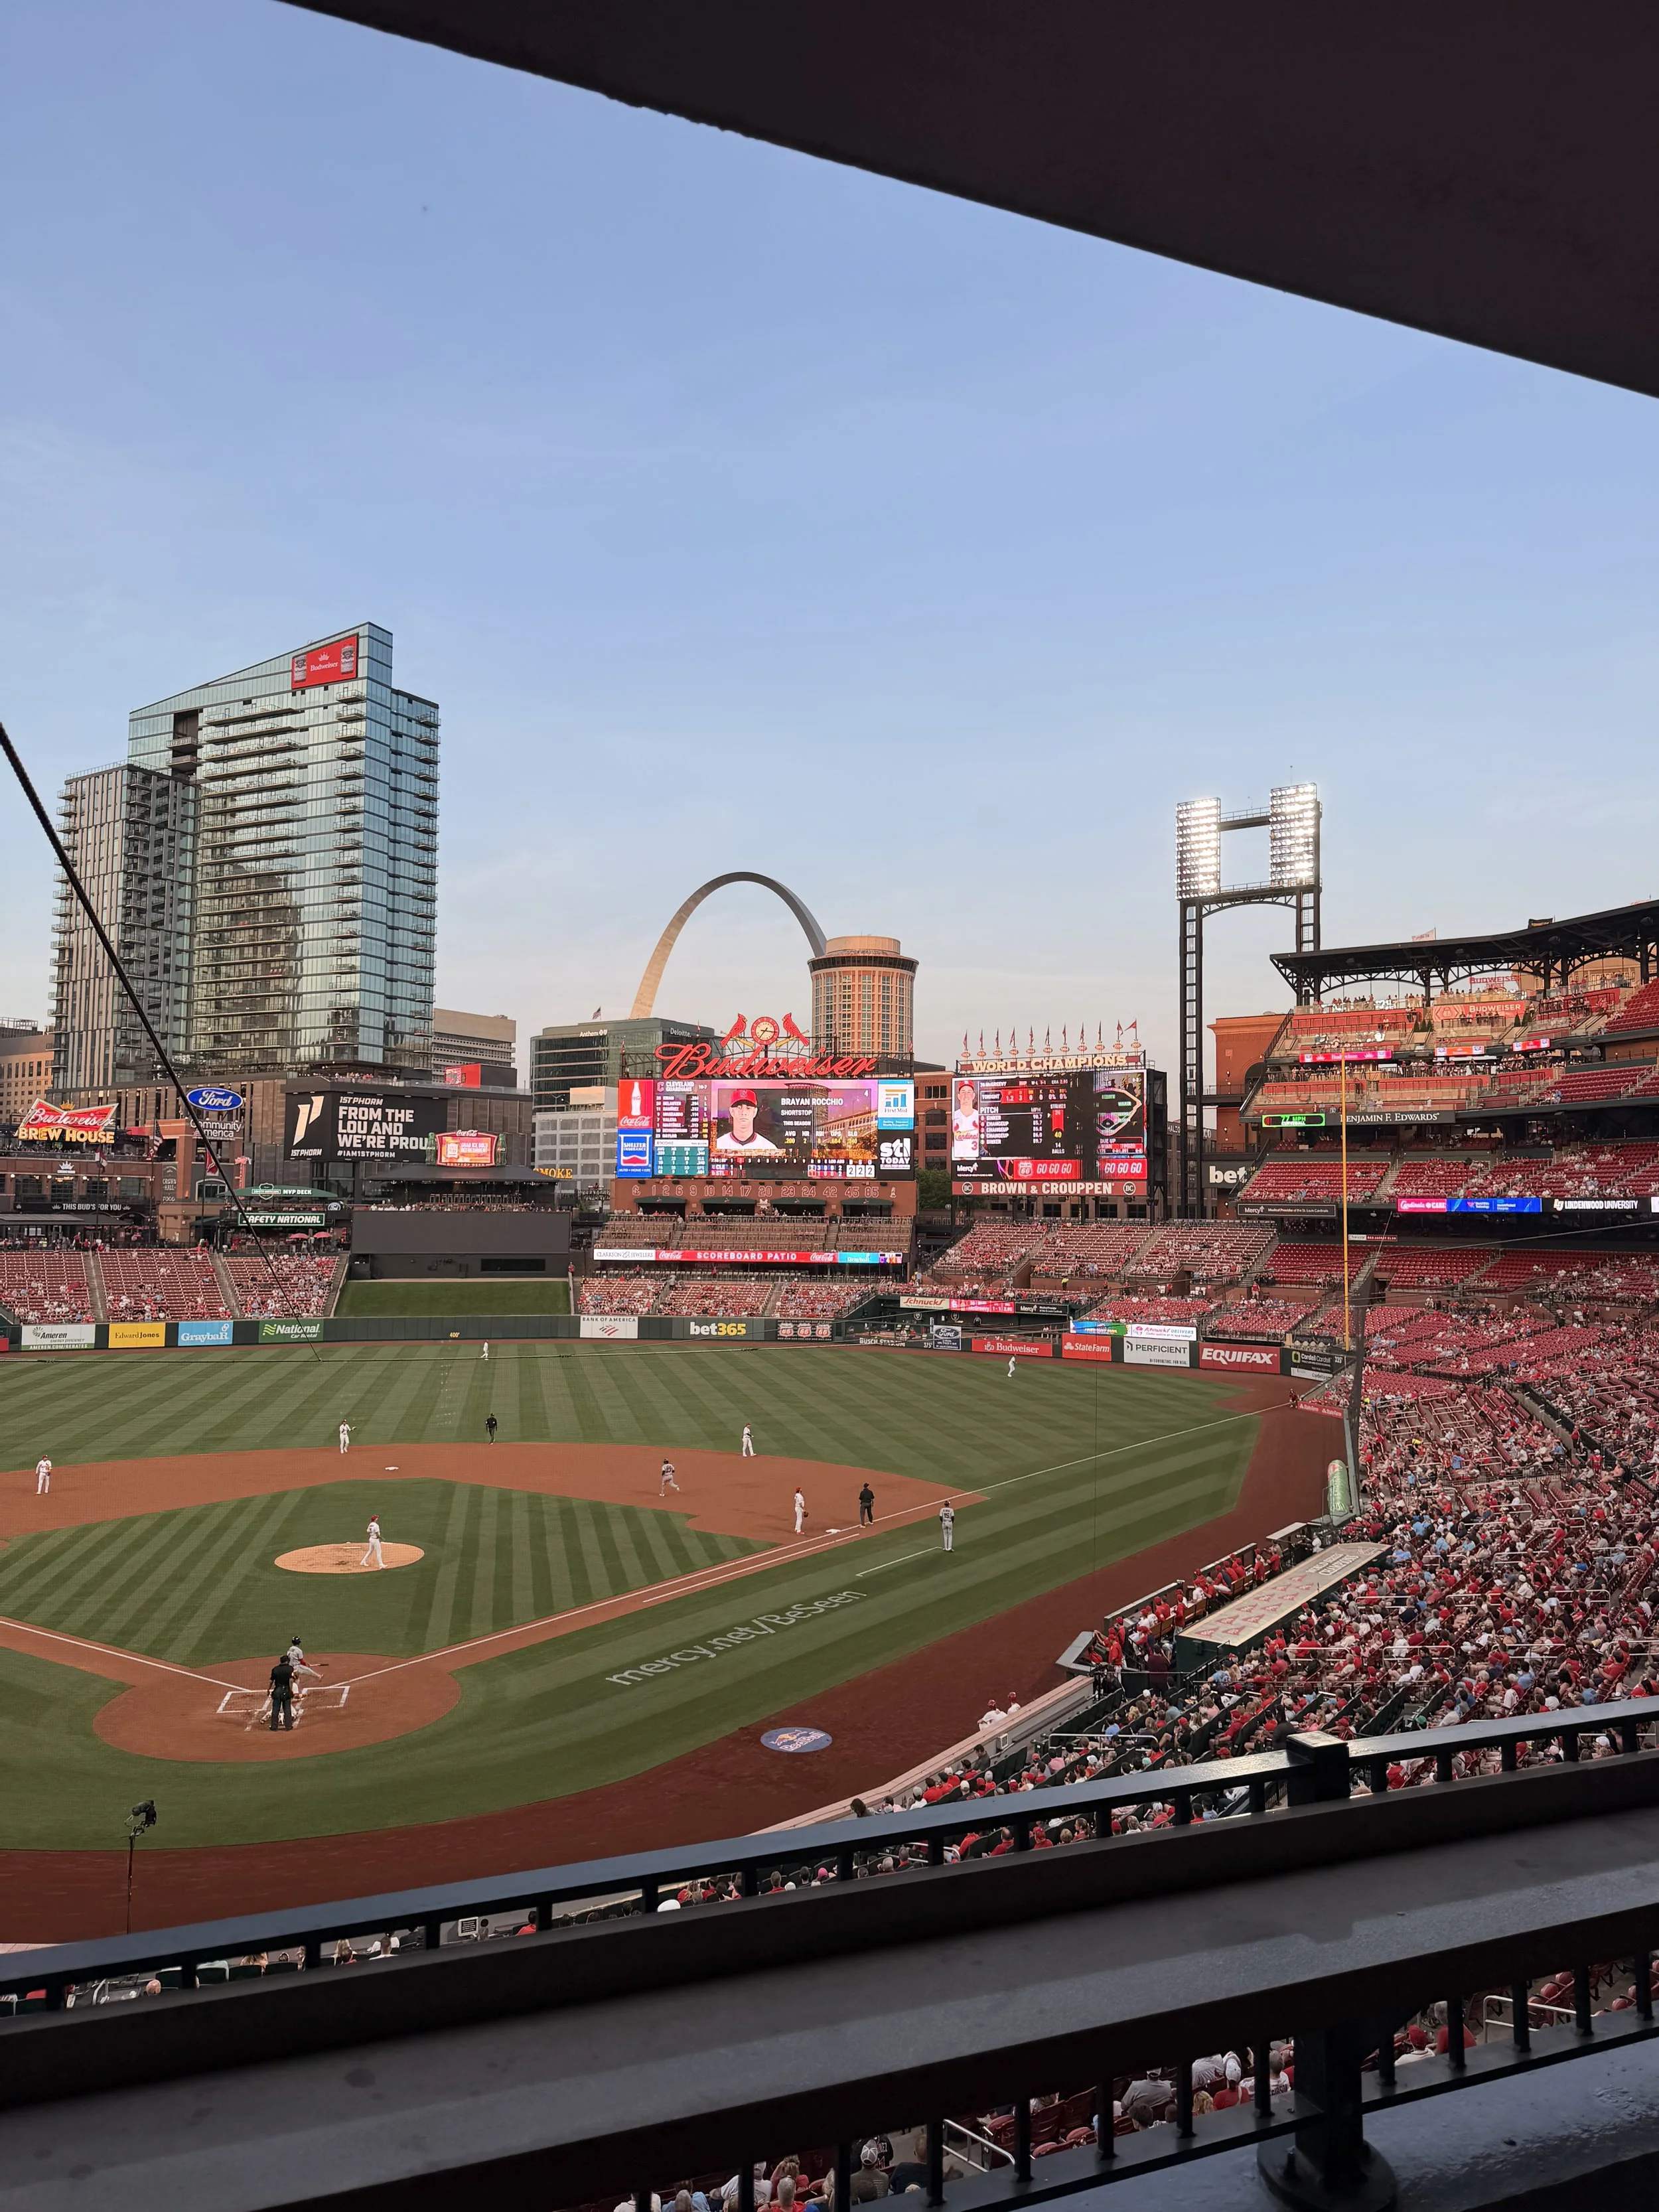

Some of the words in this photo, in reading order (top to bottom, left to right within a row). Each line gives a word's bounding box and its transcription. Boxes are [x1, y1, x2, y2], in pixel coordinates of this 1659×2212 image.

[310, 662, 338, 672] Budweiser
[1469, 1003, 1520, 1013] BUDWEISER
[654, 1043, 877, 1079] Budweiser
[973, 1061, 1027, 1072] WORLD
[1031, 1056, 1127, 1070] CHAMPIONS
[198, 1090, 233, 1107] Ford
[29, 1108, 115, 1126] Budweiser
[338, 1106, 382, 1121] FROM
[386, 1109, 414, 1122] THE
[1340, 1114, 1383, 1124] ENJAMIN
[1386, 1114, 1392, 1122] F.
[1395, 1113, 1437, 1122] EDWARDS
[620, 1116, 652, 1126] Coca-Cola
[338, 1120, 368, 1134] LOU
[371, 1122, 403, 1136] AND
[19, 1128, 62, 1141] BREW
[65, 1128, 115, 1143] HOUSE
[337, 1134, 386, 1149] WE'RE
[390, 1136, 437, 1150] PROU
[880, 1138, 910, 1157] stl
[1037, 1163, 1046, 1173] GO
[1049, 1163, 1059, 1173] GO
[1062, 1163, 1072, 1173] GO
[1104, 1163, 1115, 1173] GO
[1118, 1163, 1127, 1173] GO
[652, 1185, 656, 1196] 1
[662, 1185, 670, 1196] 2
[676, 1185, 684, 1196] 6
[690, 1185, 697, 1196] 9
[704, 1185, 715, 1197] 10
[722, 1185, 733, 1197] 14
[740, 1185, 752, 1197] 17
[758, 1185, 772, 1197] 20
[781, 1186, 795, 1197] 23
[802, 1186, 816, 1197] 24
[823, 1187, 837, 1198] 42
[845, 1187, 859, 1198] 45
[865, 1187, 879, 1198] 85
[981, 1183, 1027, 1194] BROWN
[1030, 1185, 1039, 1194] &
[1400, 1201, 1425, 1209] Cardinals
[1565, 1201, 1603, 1210] LINDENWOOD
[1605, 1201, 1638, 1209] UNIVERSITY
[658, 1251, 682, 1260] Coca-Cola
[810, 1252, 833, 1262] Coca-Cola
[690, 1322, 747, 1336] bet365
[938, 1328, 957, 1338] Ford
[997, 1343, 1039, 1354] Budweiser
[1136, 1345, 1187, 1354] PERFICIENT
[1202, 1348, 1273, 1364] EQUIFAX
[606, 1590, 867, 1686] mercy.net/BeSeen
